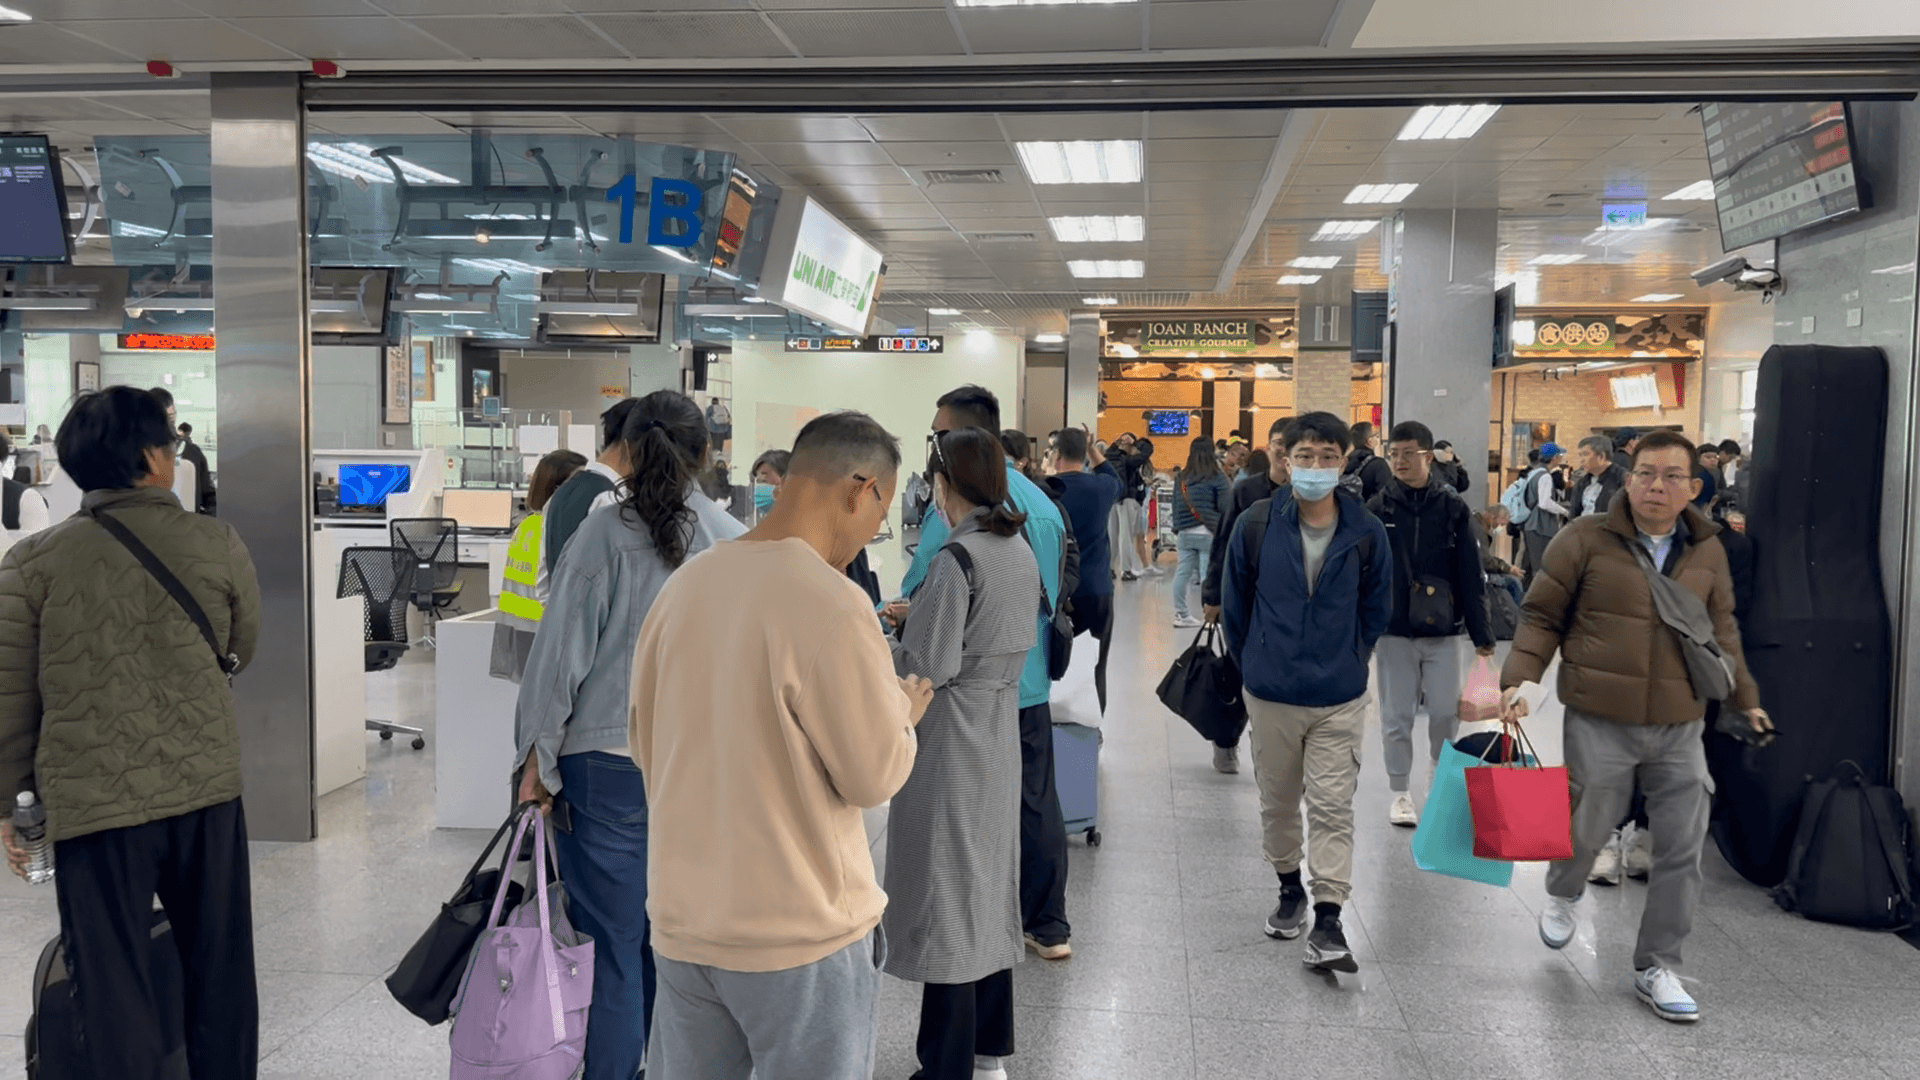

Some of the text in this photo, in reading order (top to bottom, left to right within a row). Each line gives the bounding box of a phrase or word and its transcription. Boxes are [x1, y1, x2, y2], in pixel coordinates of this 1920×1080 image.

[605, 173, 704, 247] 1B
[1148, 323, 1248, 337] JOAN RANCH
[1148, 339, 1249, 347] CREATIVE GOURMET
